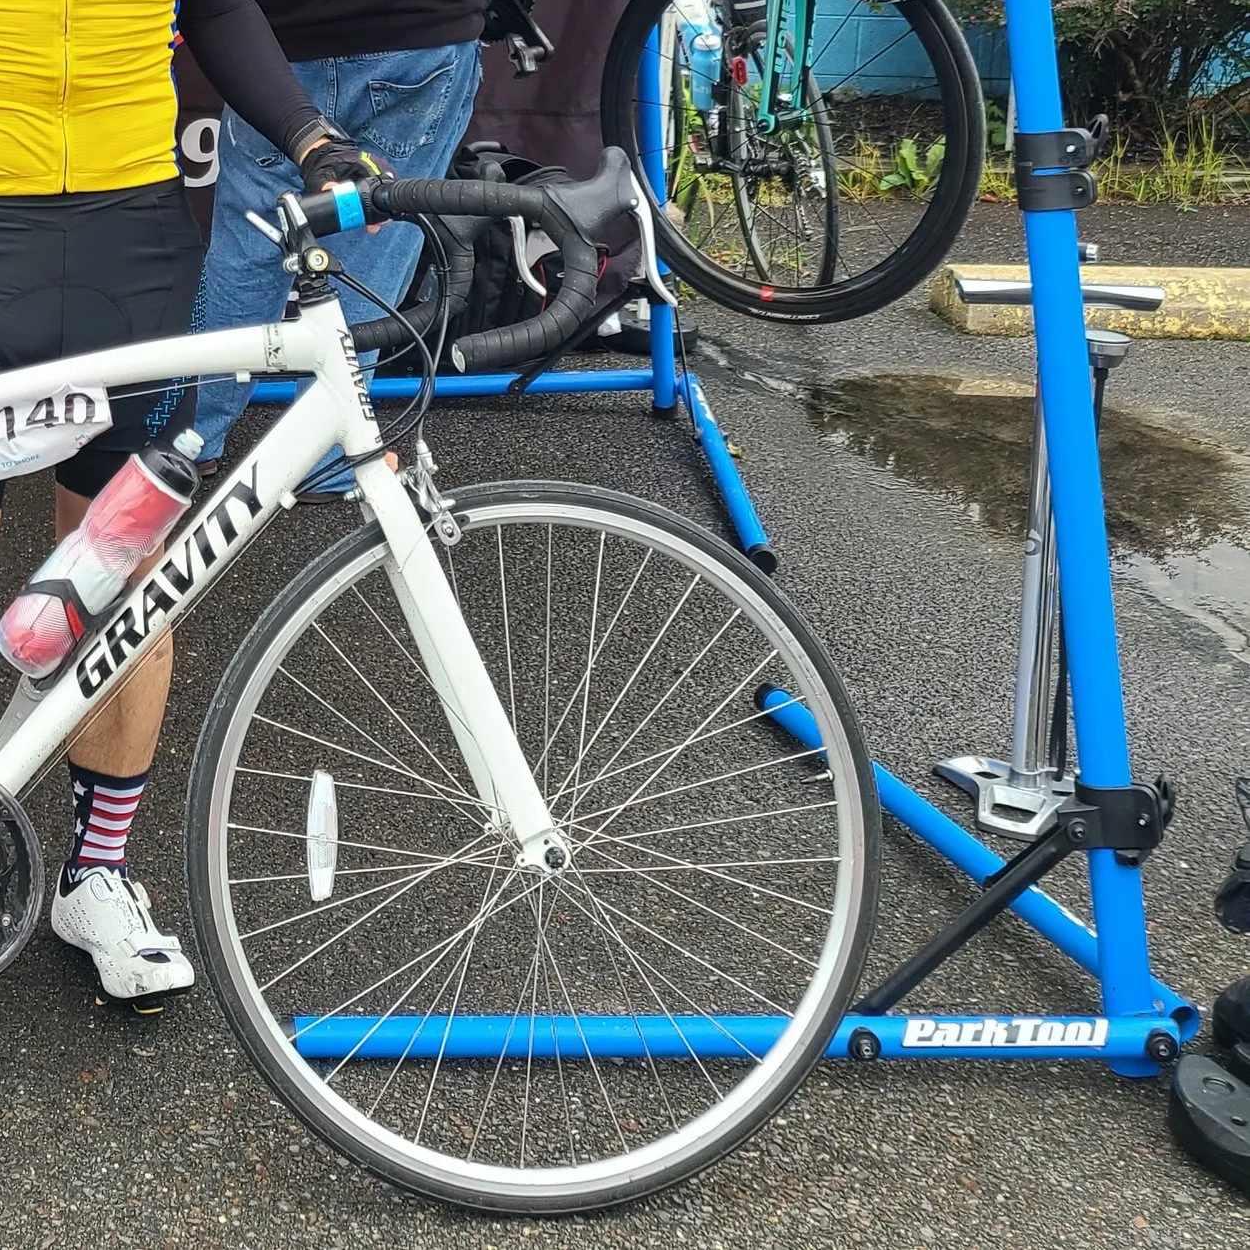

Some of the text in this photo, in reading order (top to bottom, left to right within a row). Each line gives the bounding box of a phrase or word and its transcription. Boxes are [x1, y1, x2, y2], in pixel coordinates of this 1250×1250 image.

[1, 459, 15, 469] TO
[14, 453, 41, 467] SHORE
[76, 460, 265, 700] GRAVITY
